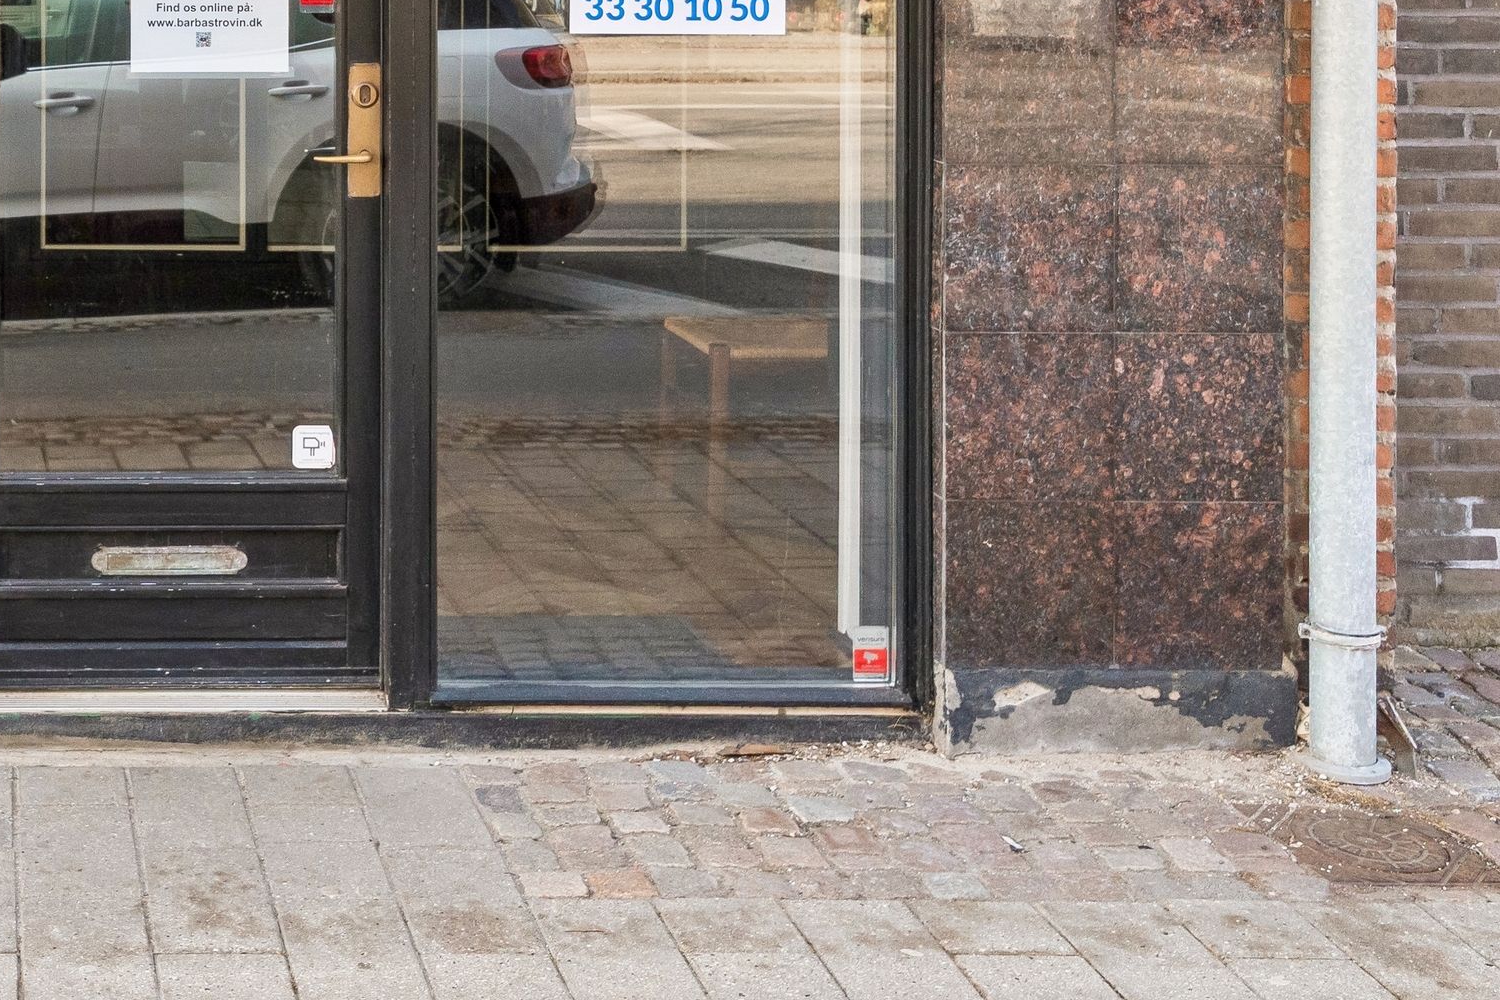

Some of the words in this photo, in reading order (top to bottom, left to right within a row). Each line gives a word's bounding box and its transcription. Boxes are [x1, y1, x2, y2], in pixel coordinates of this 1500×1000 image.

[156, 3, 180, 12] Find
[200, 3, 234, 12] online
[237, 2, 253, 15] på:
[147, 18, 263, 28] www.barbastrovin.dk
